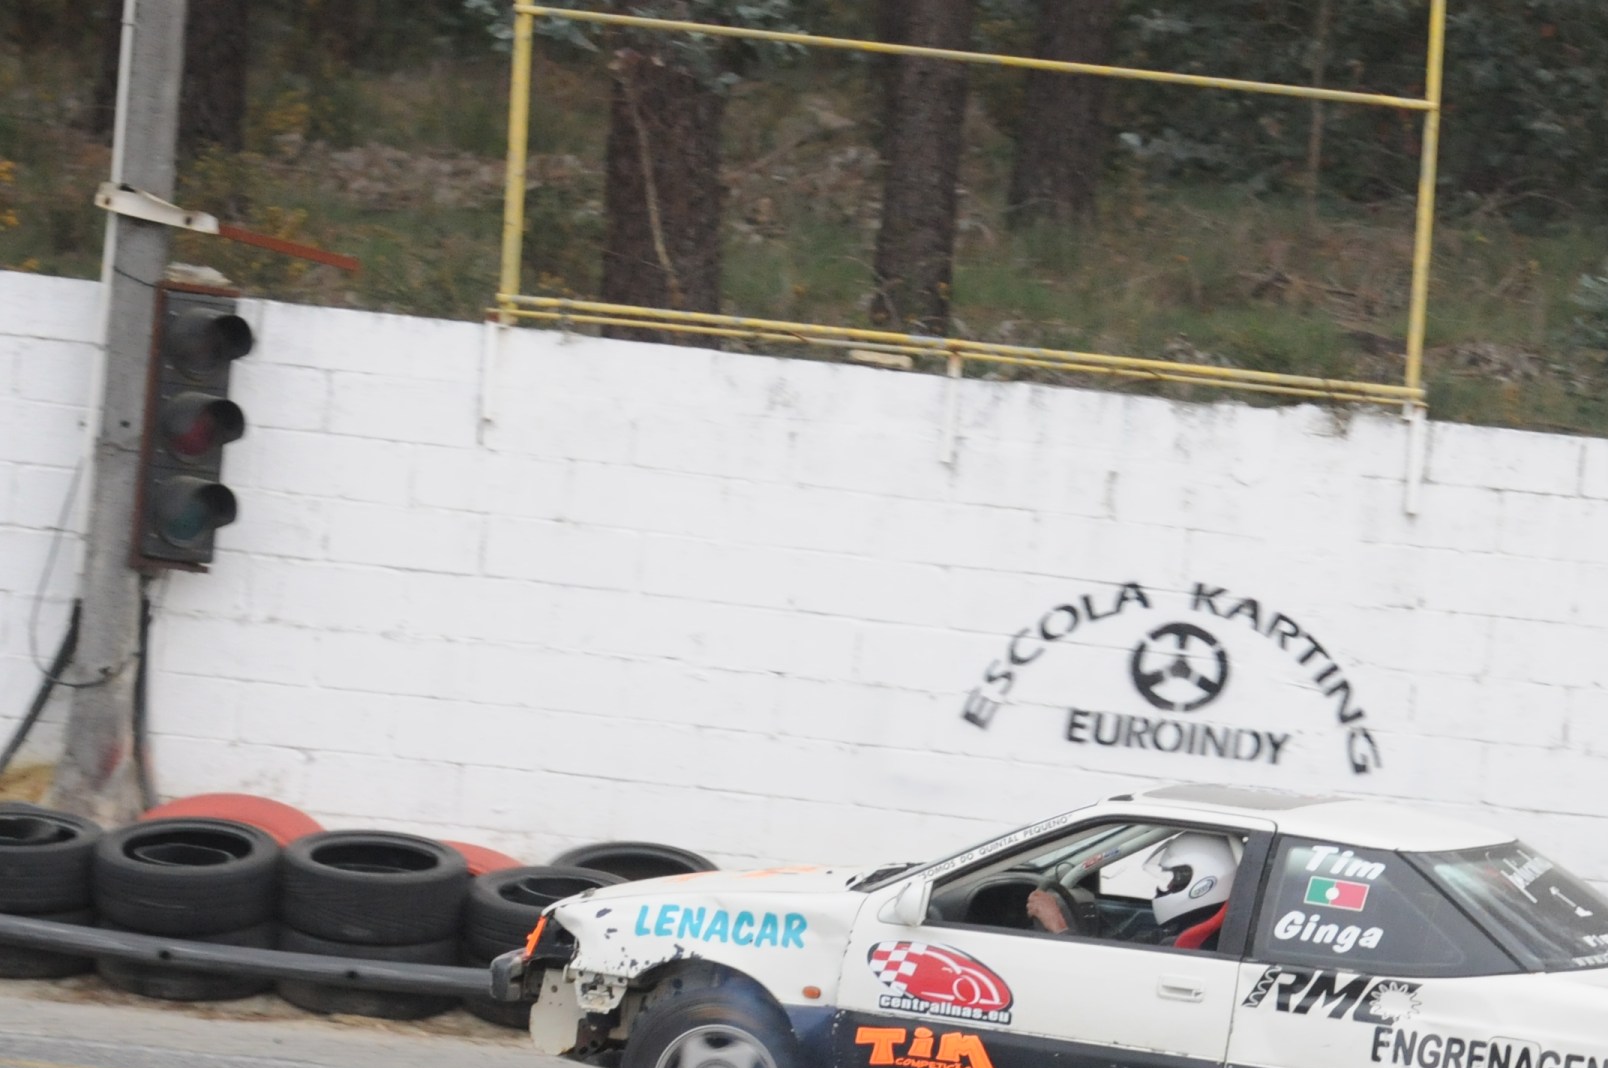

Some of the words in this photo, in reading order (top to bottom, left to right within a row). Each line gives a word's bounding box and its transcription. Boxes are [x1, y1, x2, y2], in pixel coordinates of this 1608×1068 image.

[960, 581, 1152, 731] ESCOLA
[1189, 581, 1383, 776] KARTING
[1064, 707, 1291, 766] EUROINDY
[1305, 845, 1386, 880] Tim
[634, 903, 808, 949] LENACAR
[1273, 910, 1384, 953] Ginga
[881, 995, 1010, 1024] centralinas.eu
